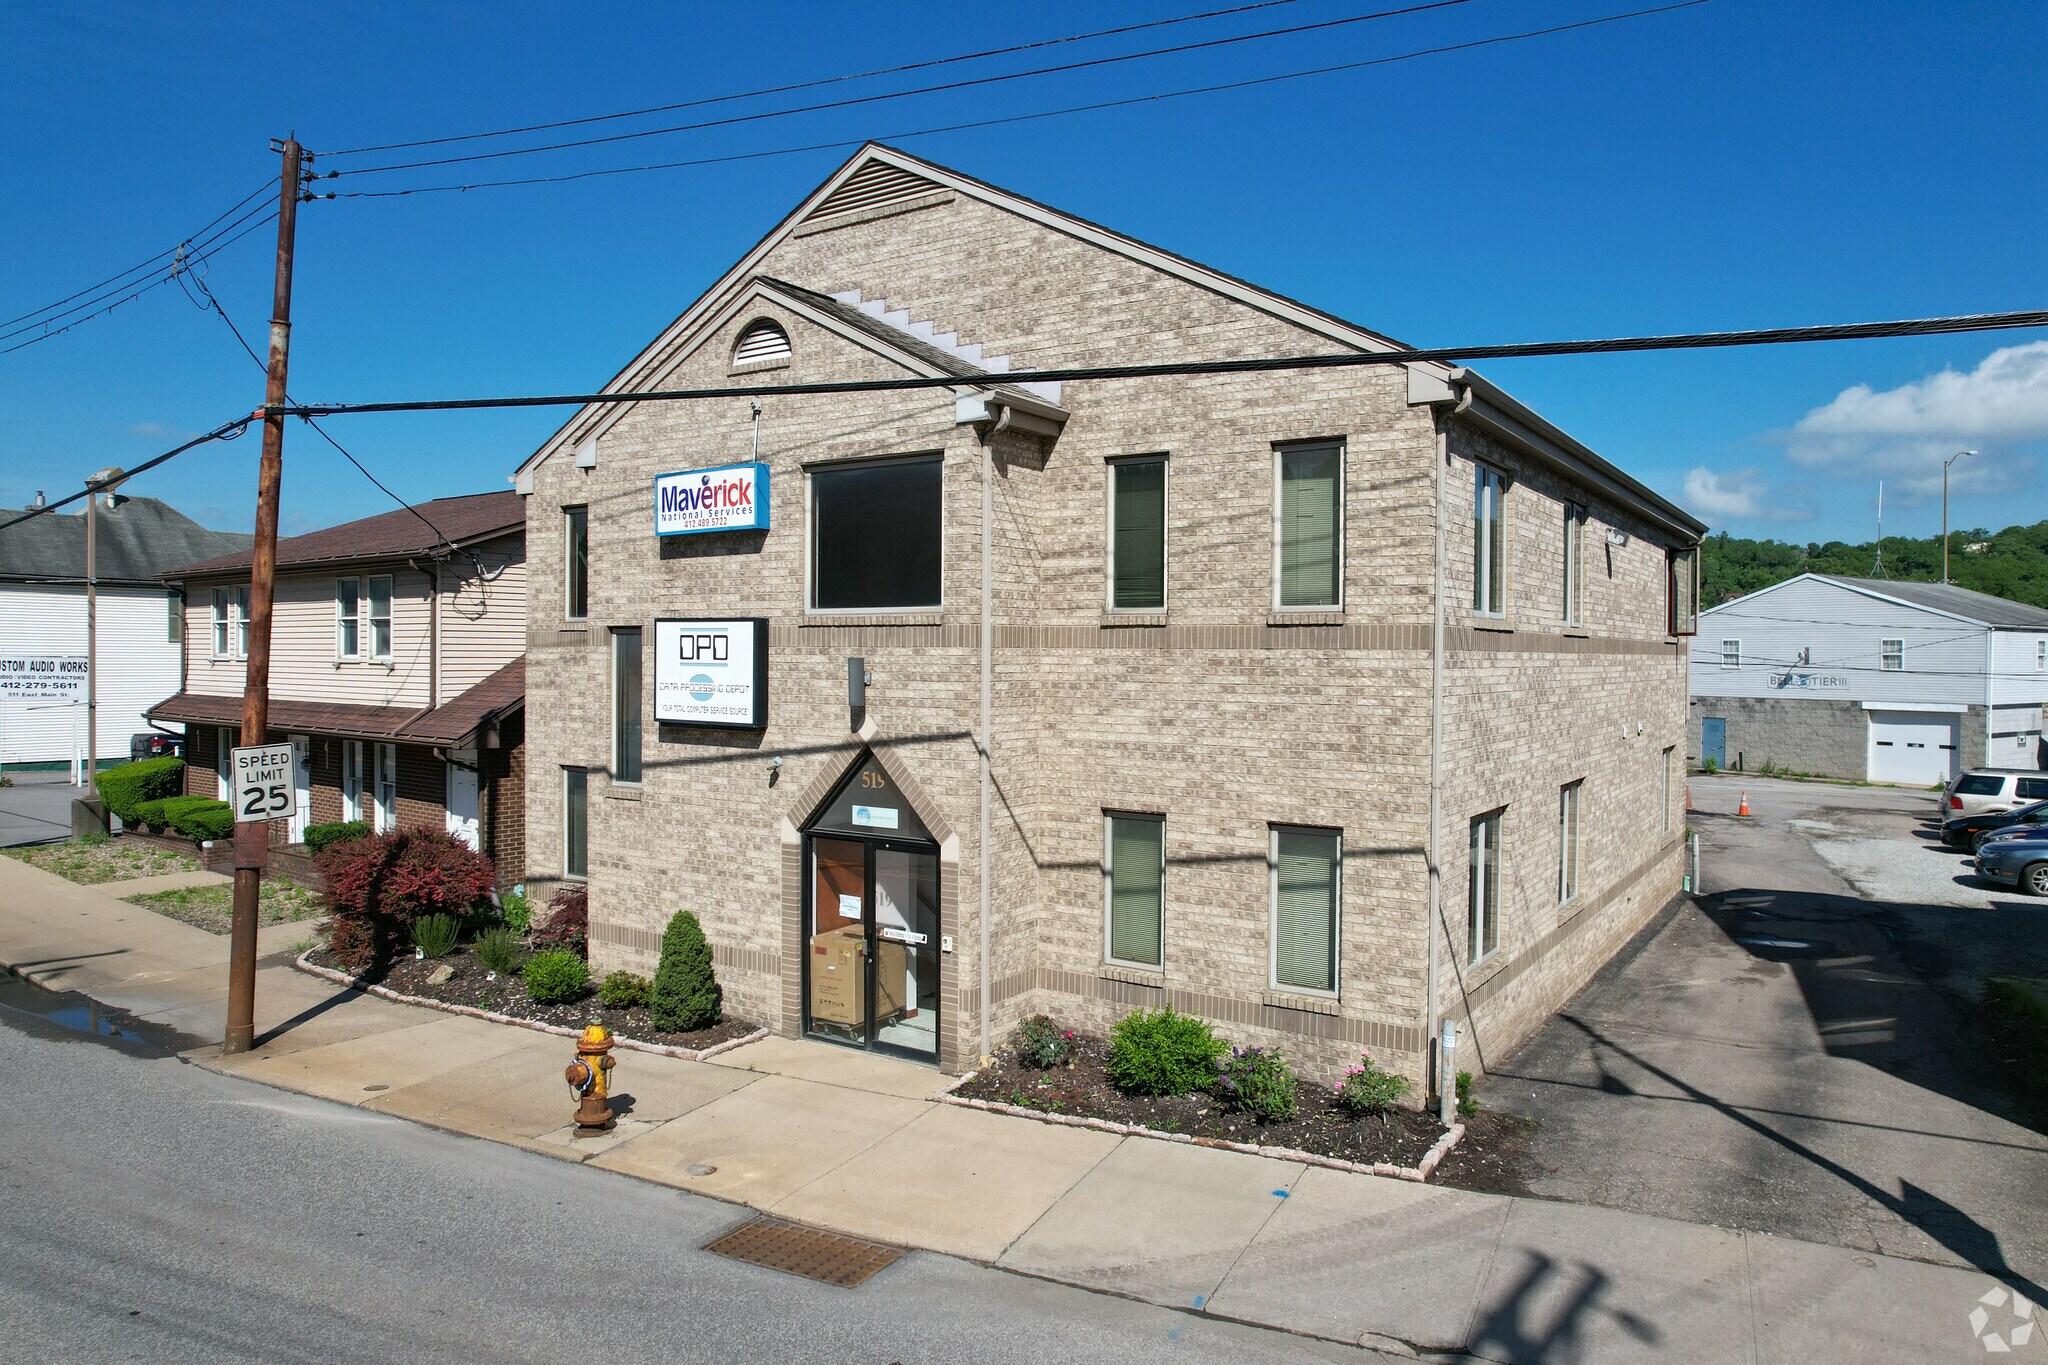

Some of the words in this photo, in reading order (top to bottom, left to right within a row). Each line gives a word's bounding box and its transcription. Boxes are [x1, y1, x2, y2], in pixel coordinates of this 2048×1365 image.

[661, 477, 752, 513] Maverick
[661, 510, 703, 522] National
[708, 506, 753, 518] Services
[684, 517, 728, 528] 412.489.5722
[0, 660, 25, 672] STOM
[30, 661, 55, 672] AUDIO
[59, 661, 88, 673] WORKS
[659, 682, 679, 691] DATA
[680, 683, 724, 693] PROCESSING
[726, 684, 749, 694] DEPOT
[687, 705, 709, 714] COMPUTER
[710, 706, 728, 715] SERVICE
[239, 753, 290, 768] SPEED
[246, 768, 284, 783] LIMIT
[243, 784, 289, 815] 25
